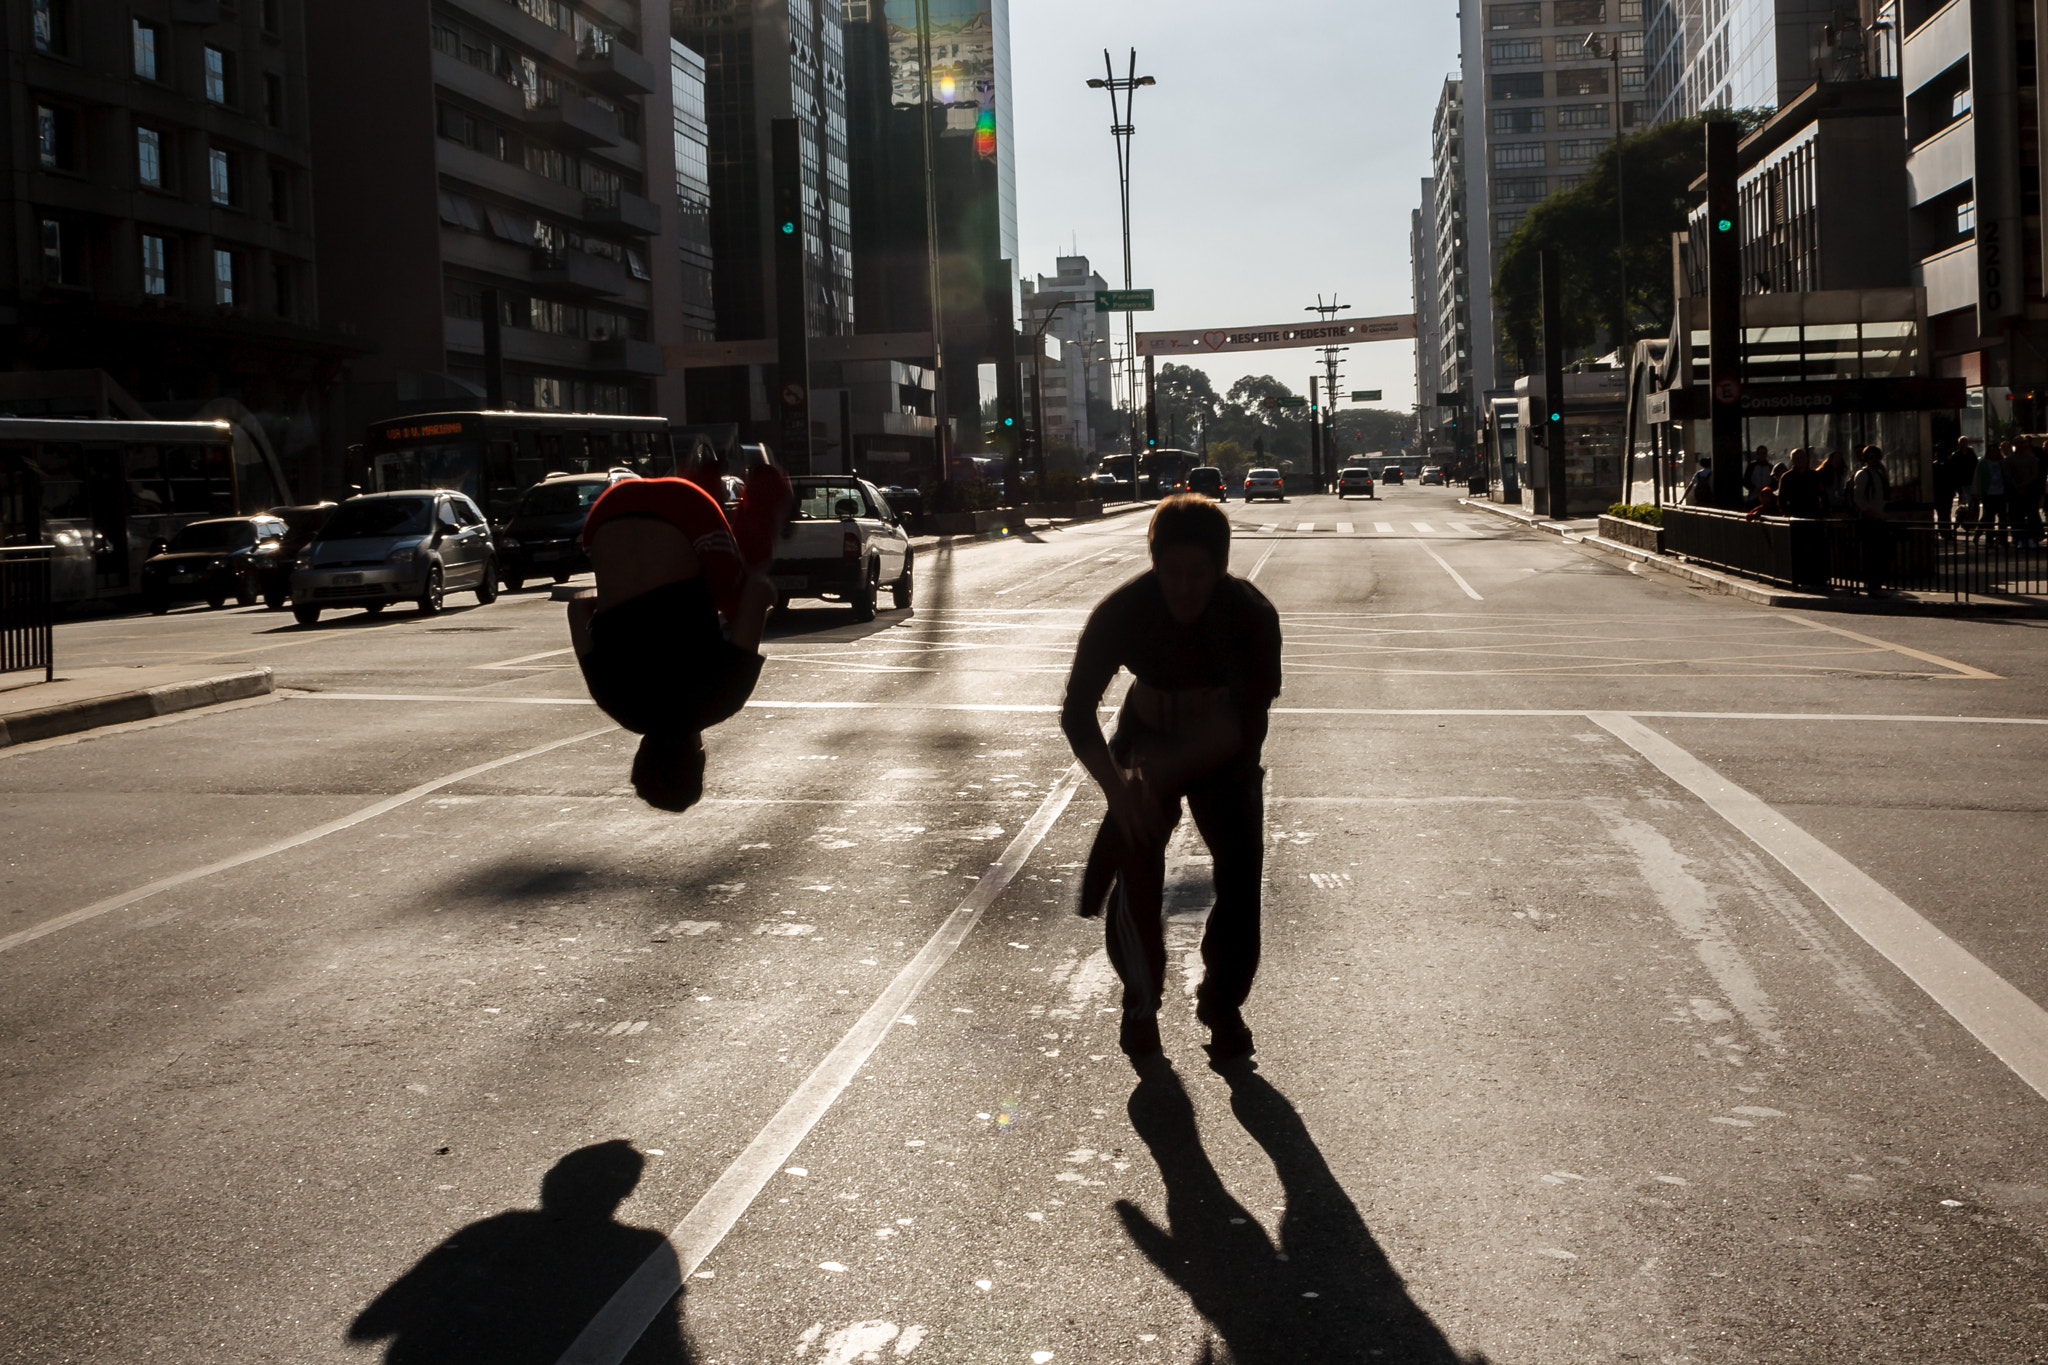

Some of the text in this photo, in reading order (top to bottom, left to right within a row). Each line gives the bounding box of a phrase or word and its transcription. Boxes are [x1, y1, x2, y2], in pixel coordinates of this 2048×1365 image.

[1984, 222, 2001, 311] 2200
[1230, 326, 1347, 345] RESPEITE O PEDESTRE
[421, 422, 463, 437] MARIANA
